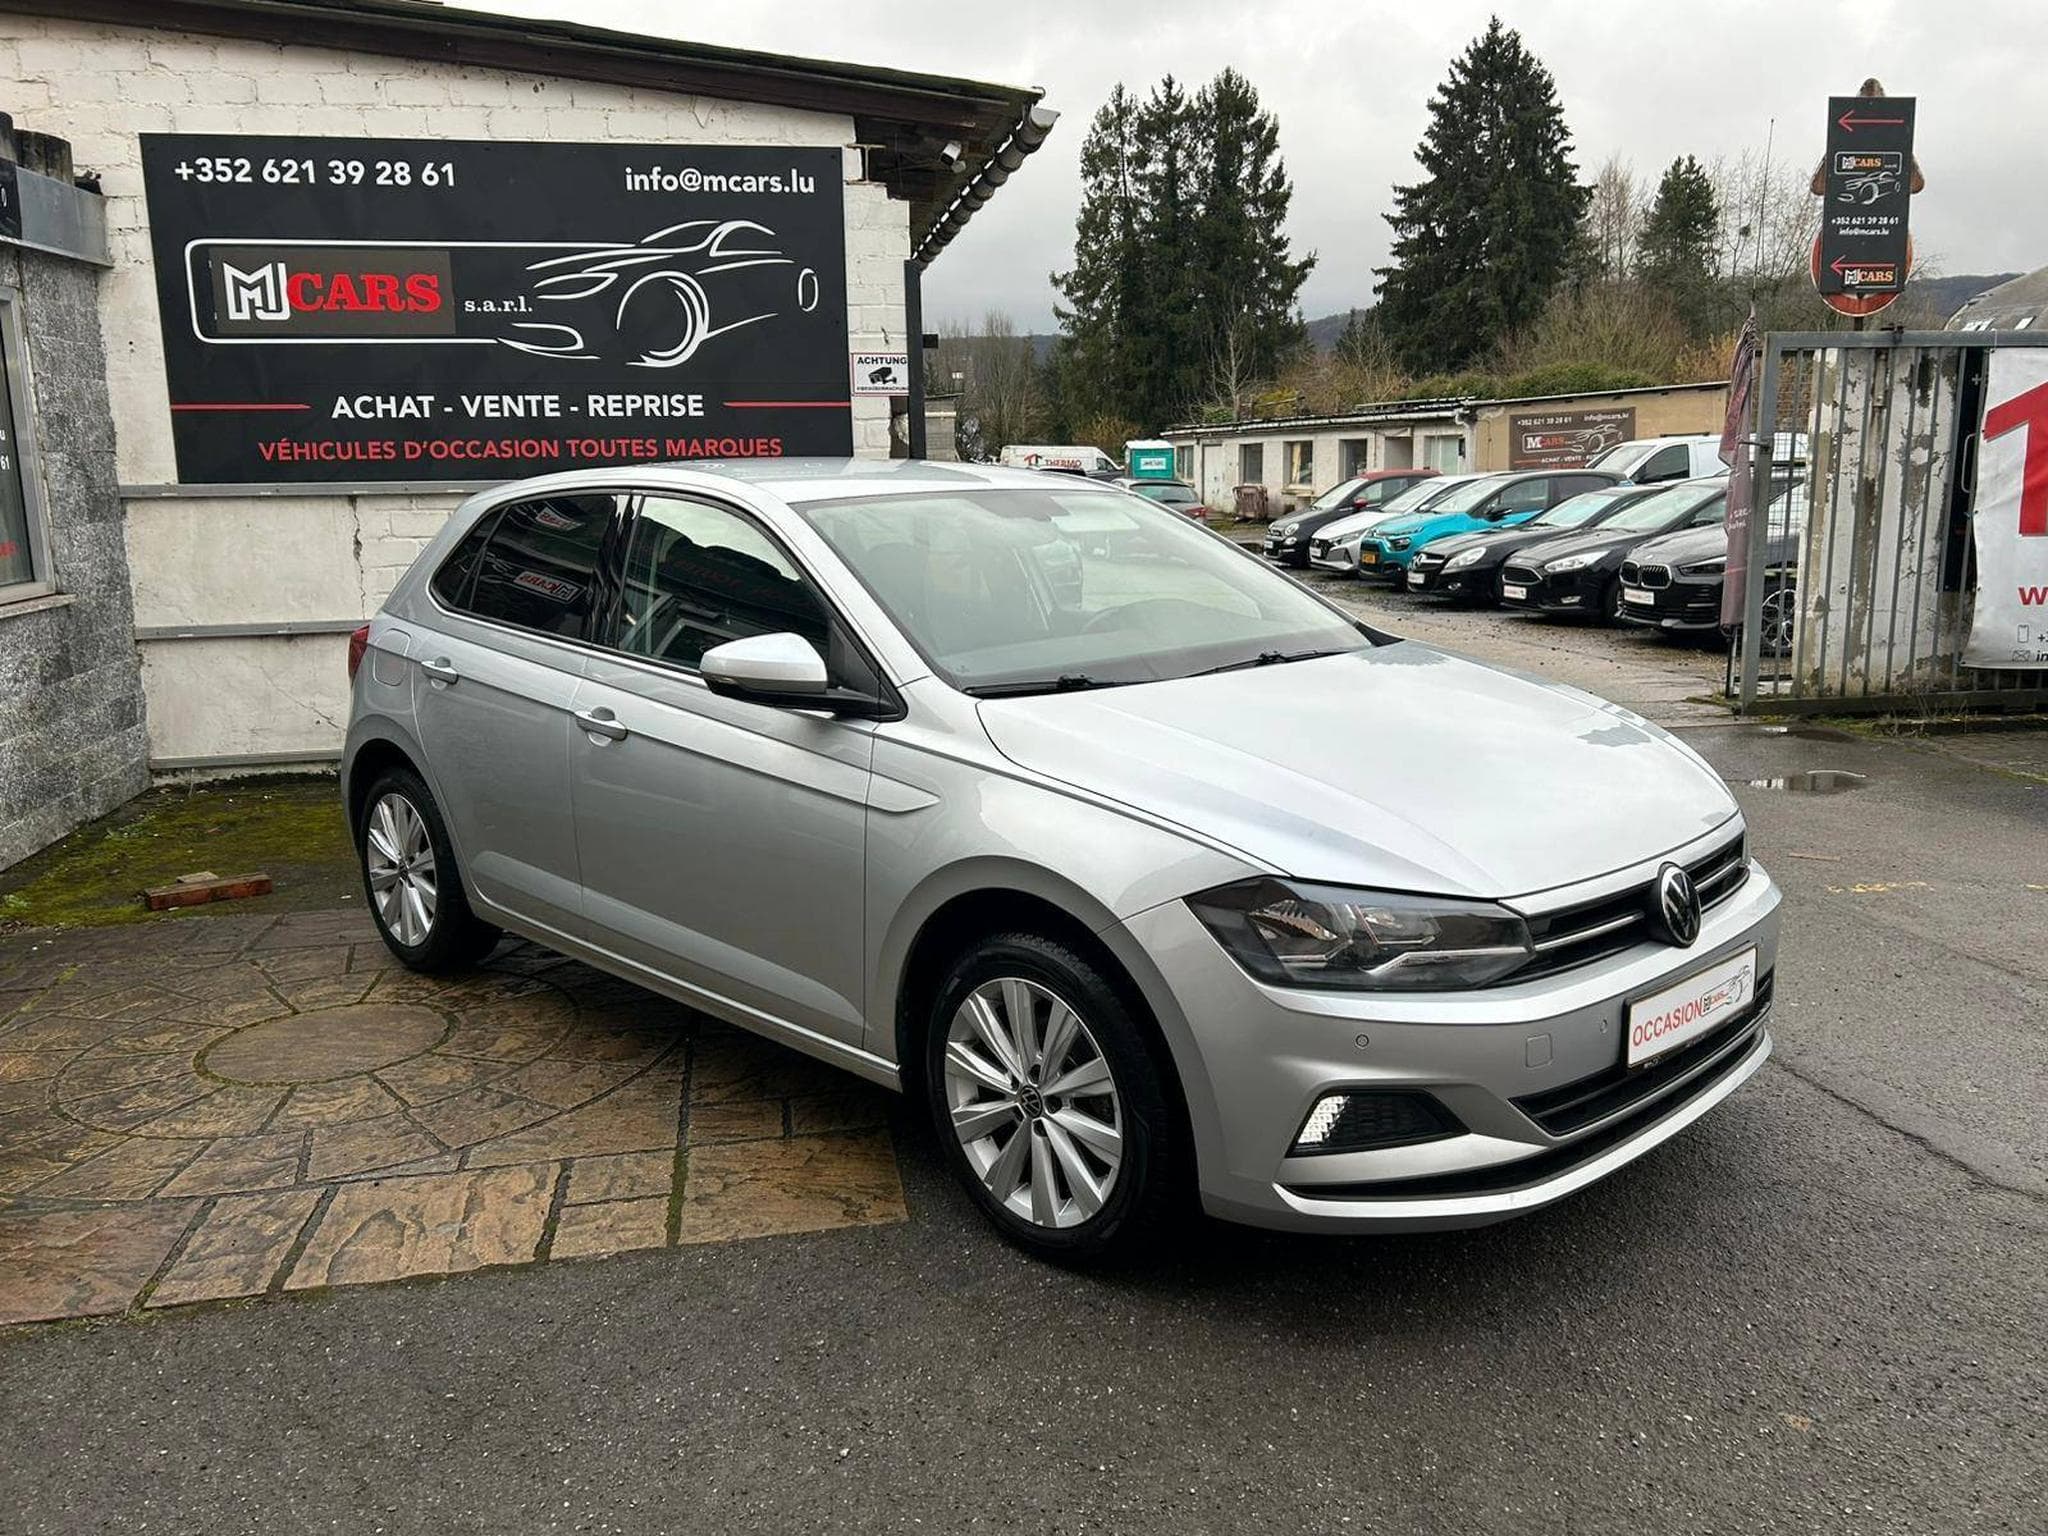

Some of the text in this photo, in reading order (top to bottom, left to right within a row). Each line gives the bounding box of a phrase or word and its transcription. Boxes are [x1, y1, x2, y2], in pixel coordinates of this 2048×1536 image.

[175, 157, 455, 187] +352 621 39 28 61
[624, 166, 815, 193] info@mcars.lu
[464, 295, 533, 312] s.a.r.l.
[857, 356, 908, 364] ACHTUNG
[331, 395, 435, 418] ACHAT
[460, 395, 561, 418] VENTE
[587, 394, 705, 418] REPRISE
[258, 437, 782, 461] VÉHICULES D'OCCASION TOUTES MARQUES
[1045, 458, 1082, 468] THERMO
[1632, 999, 1702, 1046] OCCASION
